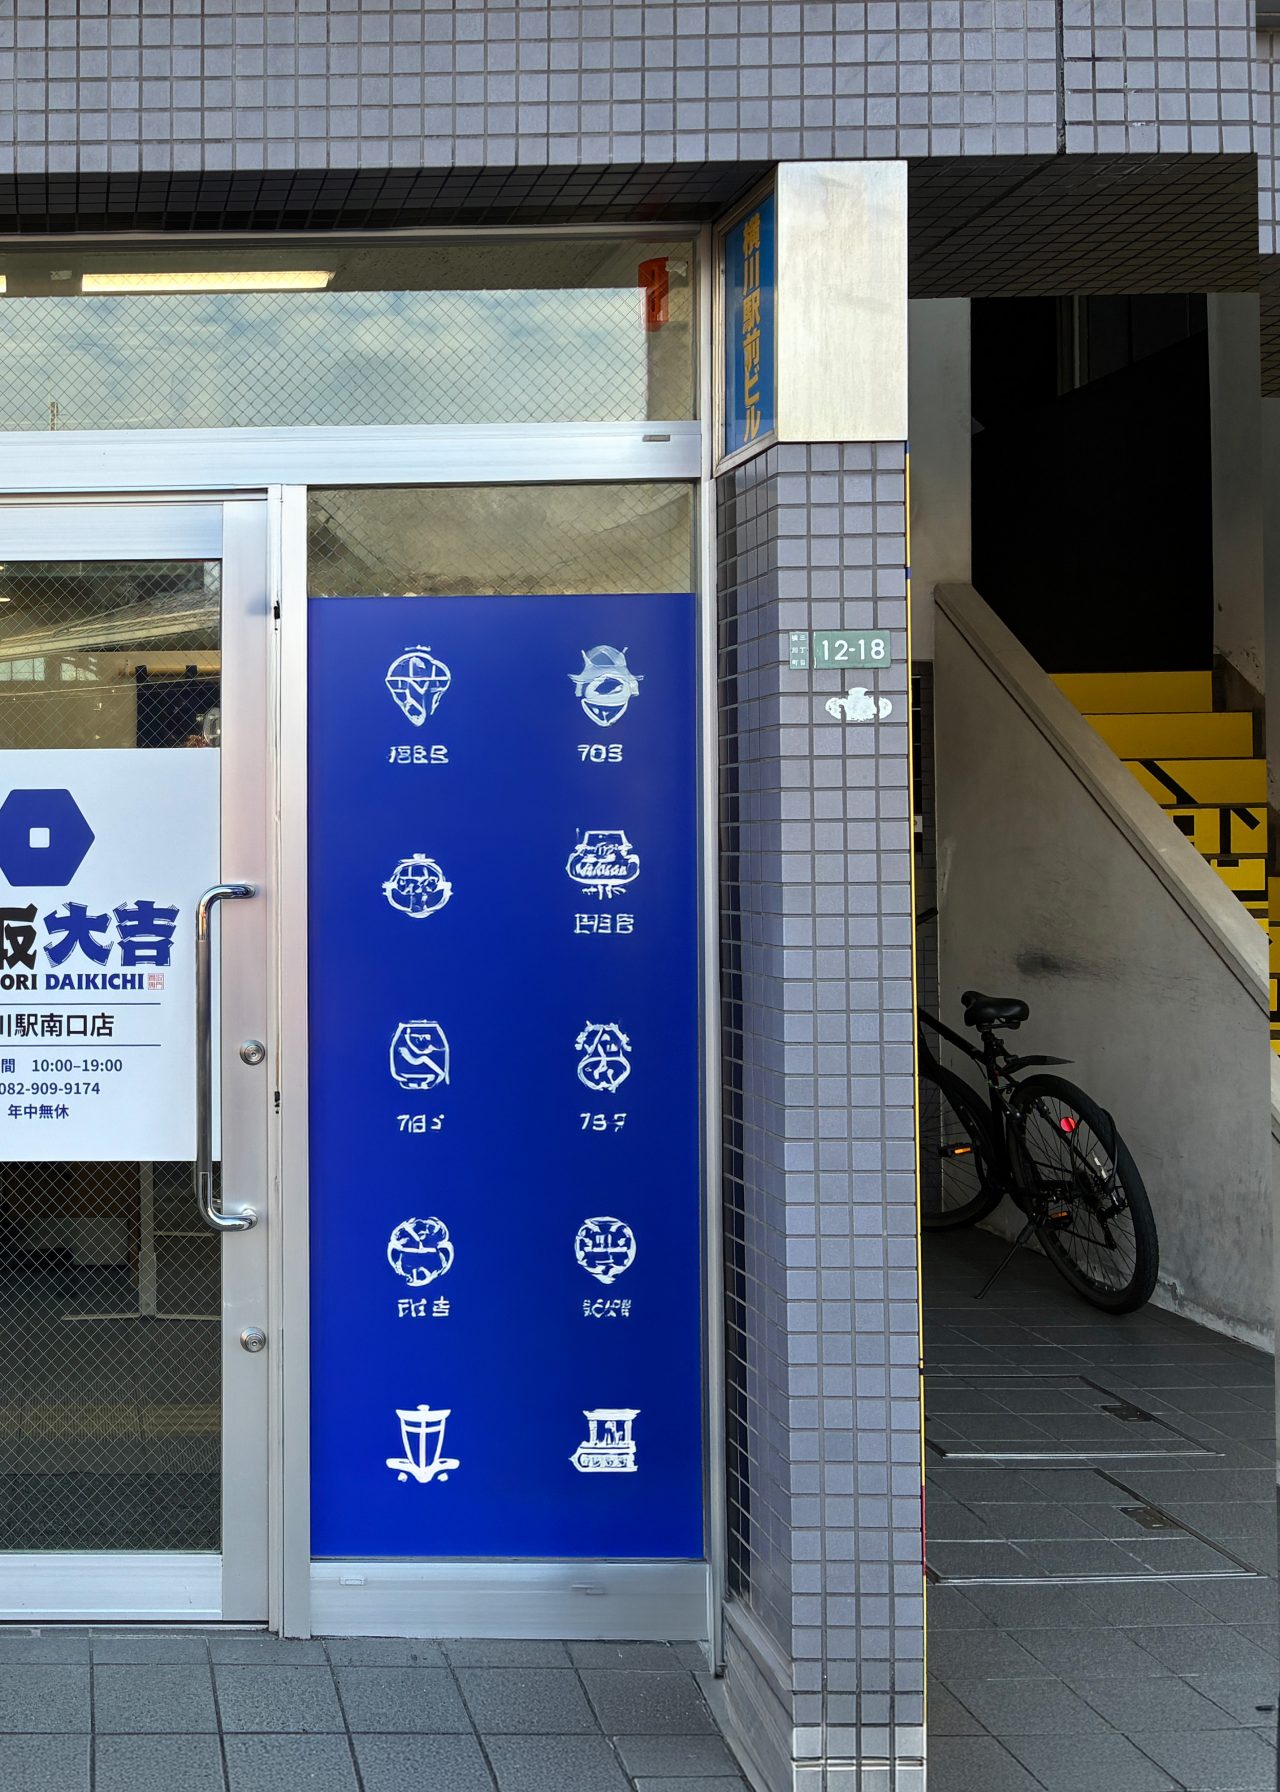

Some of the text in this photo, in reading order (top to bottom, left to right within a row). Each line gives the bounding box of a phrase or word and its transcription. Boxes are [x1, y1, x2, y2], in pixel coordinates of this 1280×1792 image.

[742, 212, 762, 443] 横川駅前ビル
[822, 639, 885, 661] 12-18
[45, 973, 144, 991] DAIKICHI
[7, 1103, 70, 1120] 年中無休
